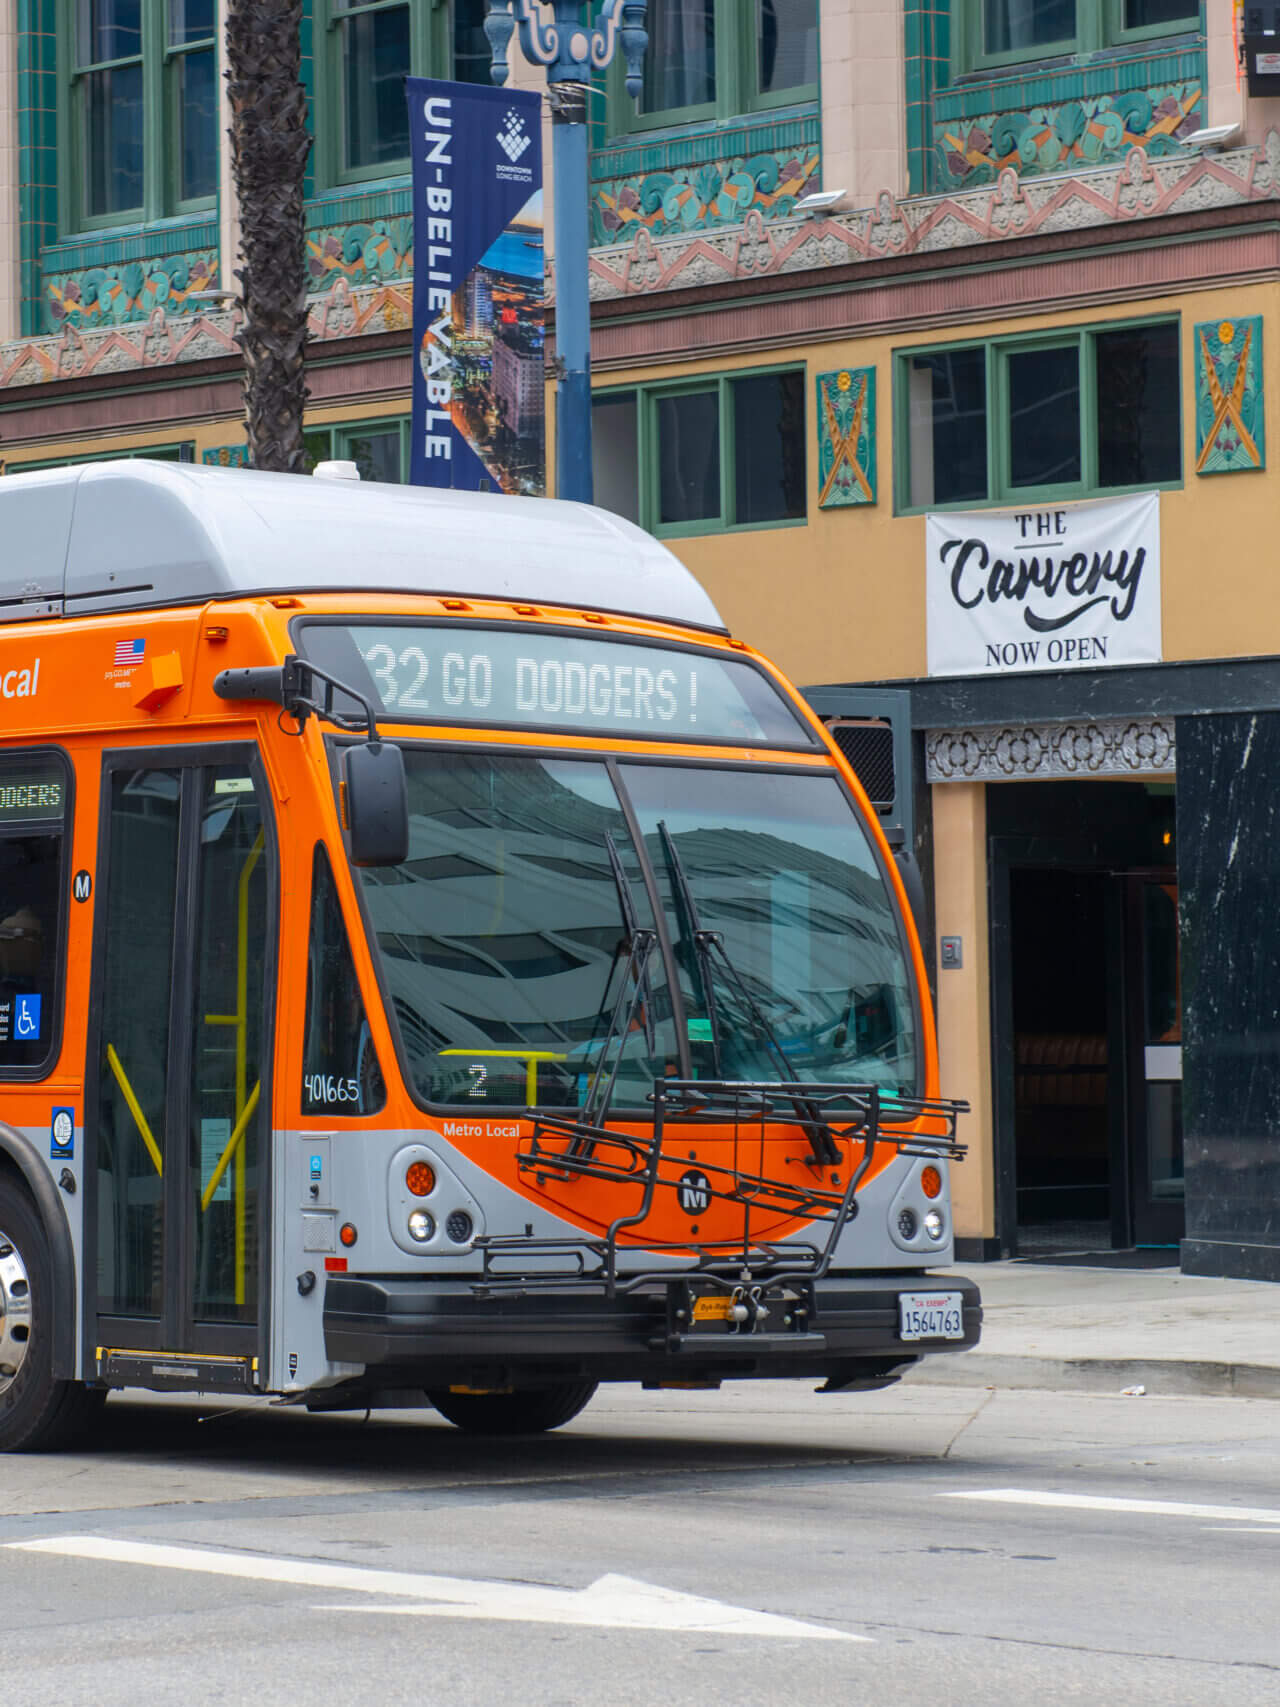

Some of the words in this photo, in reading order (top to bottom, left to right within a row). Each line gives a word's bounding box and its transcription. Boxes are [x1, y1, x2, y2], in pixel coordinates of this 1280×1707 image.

[424, 96, 452, 460] UN-BELIEVABLE
[1015, 511, 1068, 538] THE
[940, 538, 1147, 622] Carvery
[985, 641, 1041, 667] NOW
[1047, 636, 1109, 664] OPEN
[360, 643, 430, 709] 32
[441, 652, 493, 707] GO
[304, 1073, 360, 1103] 401665
[468, 1064, 487, 1097] 2
[443, 1123, 482, 1137] Metro
[486, 1123, 521, 1138] Local
[682, 1177, 707, 1208] M
[905, 1310, 960, 1333] 1564763
